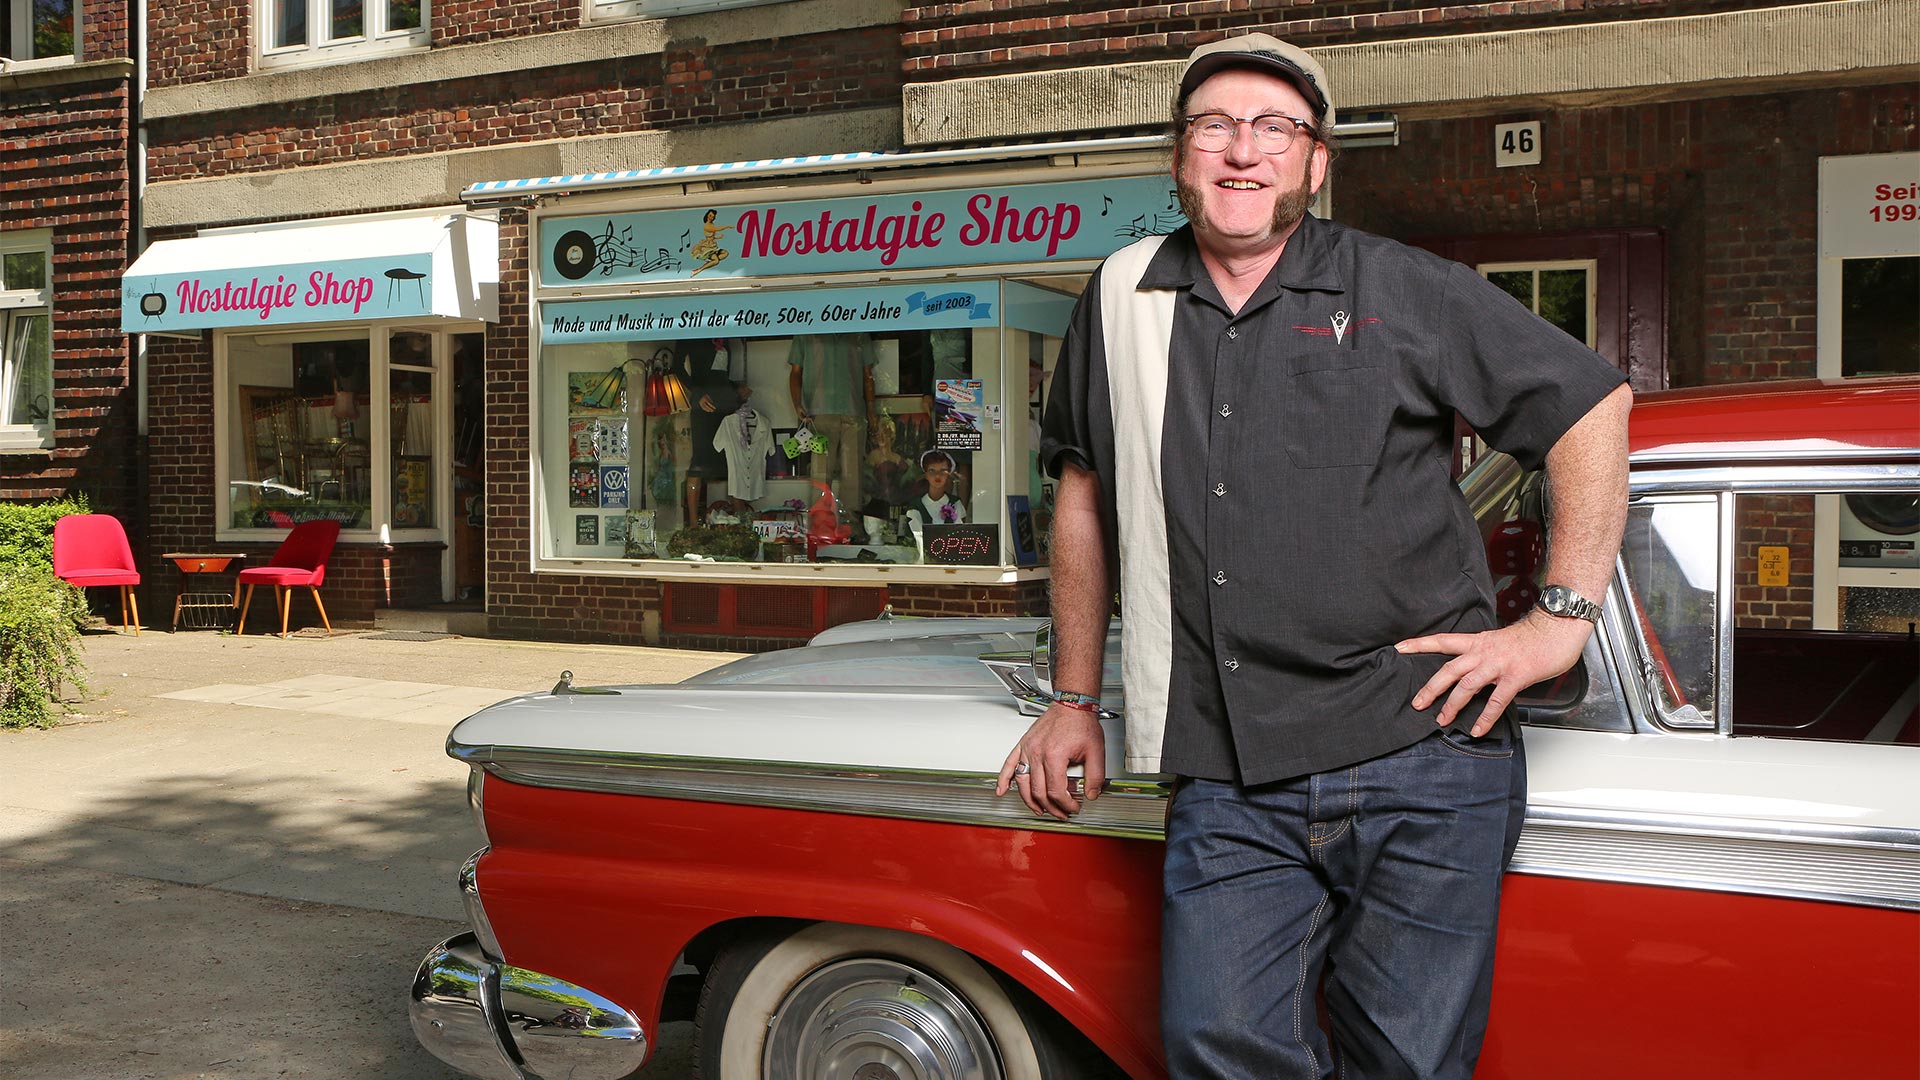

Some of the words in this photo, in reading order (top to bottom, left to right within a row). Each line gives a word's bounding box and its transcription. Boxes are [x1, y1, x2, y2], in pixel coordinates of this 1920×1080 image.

[1501, 129, 1534, 154] 46
[1875, 182, 1920, 201] Sei
[1869, 204, 1920, 223] 199
[737, 203, 945, 265] Nostalgie
[959, 193, 1081, 257] Shop
[176, 276, 297, 320] Nostalgie
[304, 270, 374, 314] Shop
[925, 300, 943, 313] seit
[945, 295, 972, 309] 2003
[552, 315, 585, 333] Mode
[589, 314, 613, 332] und
[616, 312, 655, 331] Musik
[658, 312, 674, 329] im
[678, 309, 704, 328] Stil
[707, 309, 730, 327] der
[733, 309, 771, 327] 40er,
[776, 307, 814, 326] 50er,
[820, 304, 857, 322] 60er
[860, 300, 901, 321] Jahre
[929, 536, 990, 555] OPEN
[1882, 541, 1891, 549] 10
